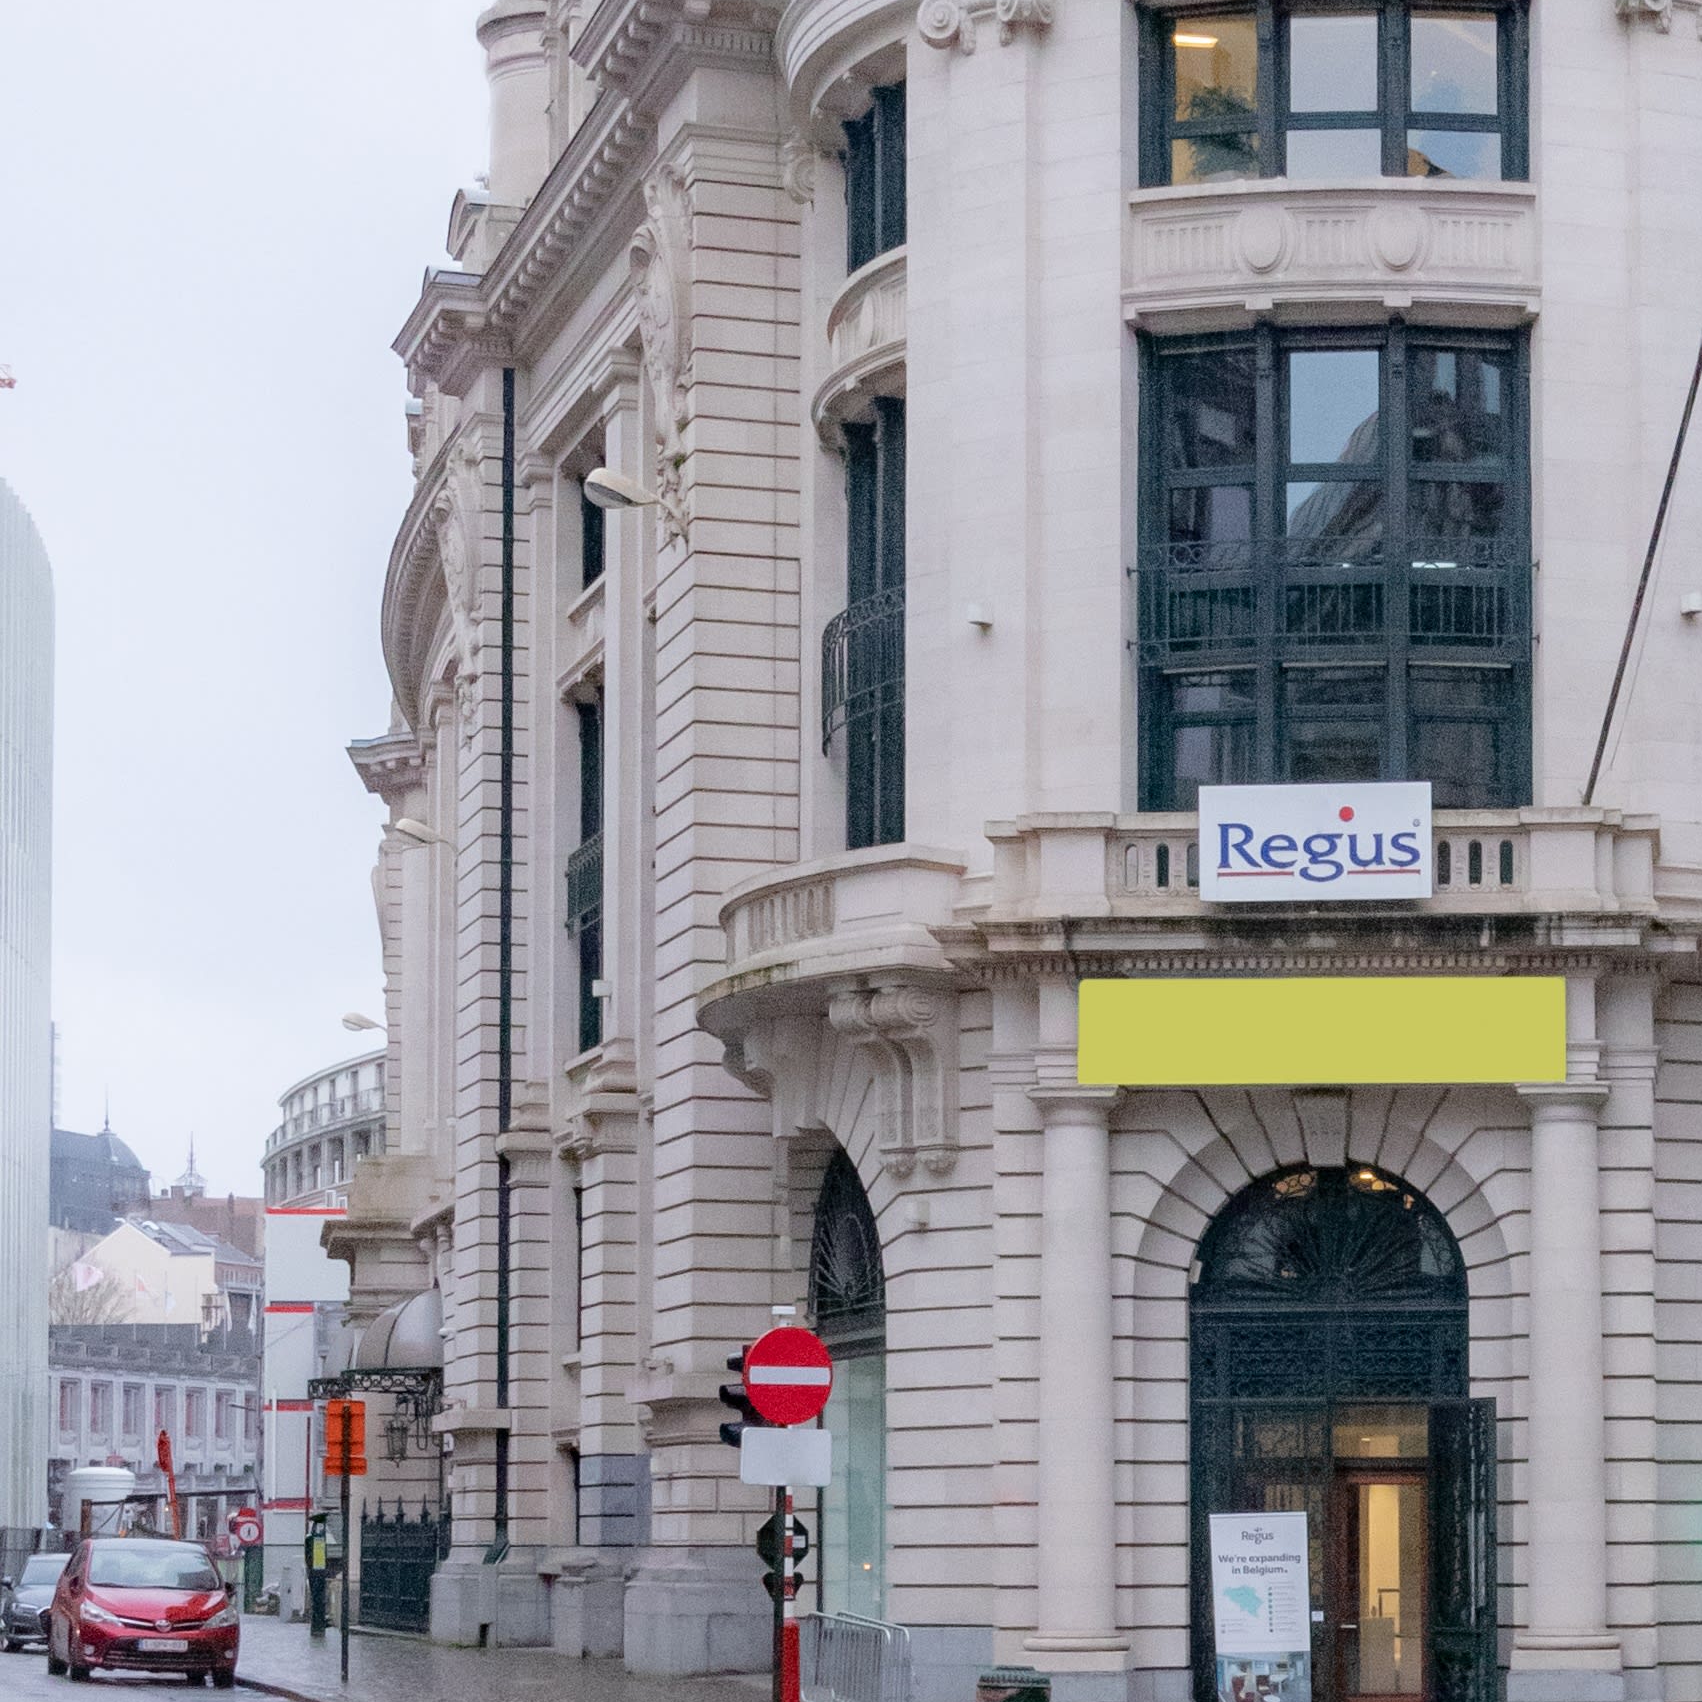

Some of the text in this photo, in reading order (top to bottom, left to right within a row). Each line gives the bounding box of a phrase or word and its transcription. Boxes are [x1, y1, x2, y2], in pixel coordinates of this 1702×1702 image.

[1241, 1530, 1274, 1545] Regus
[1218, 1553, 1301, 1564] We're expanding
[1231, 1565, 1288, 1576] in Belgium.
